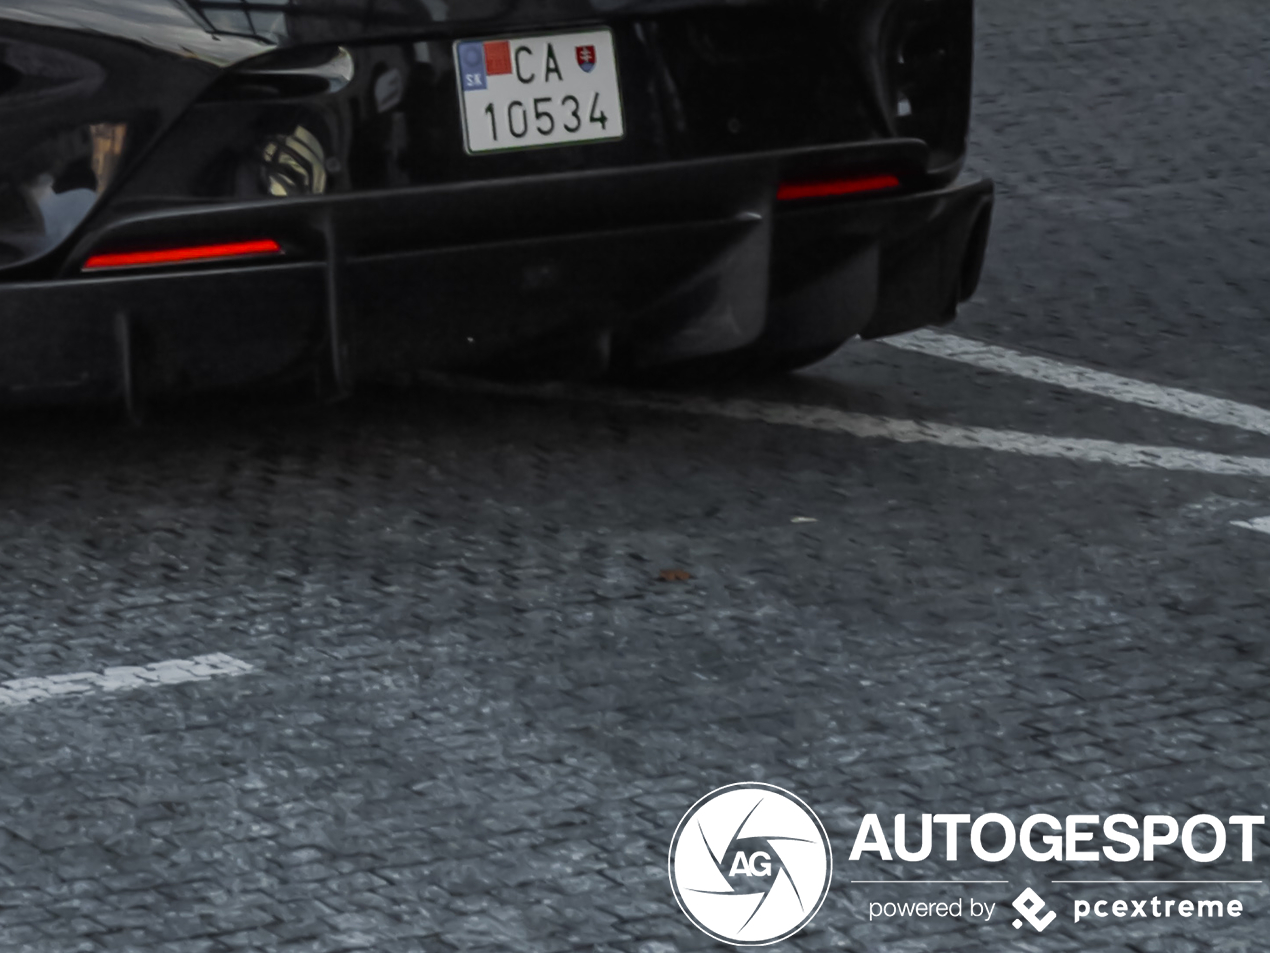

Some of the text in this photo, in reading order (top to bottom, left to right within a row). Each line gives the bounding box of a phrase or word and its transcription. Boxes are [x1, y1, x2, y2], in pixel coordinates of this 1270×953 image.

[466, 73, 482, 87] SK
[514, 42, 564, 84] CA
[485, 91, 608, 141] 10534
